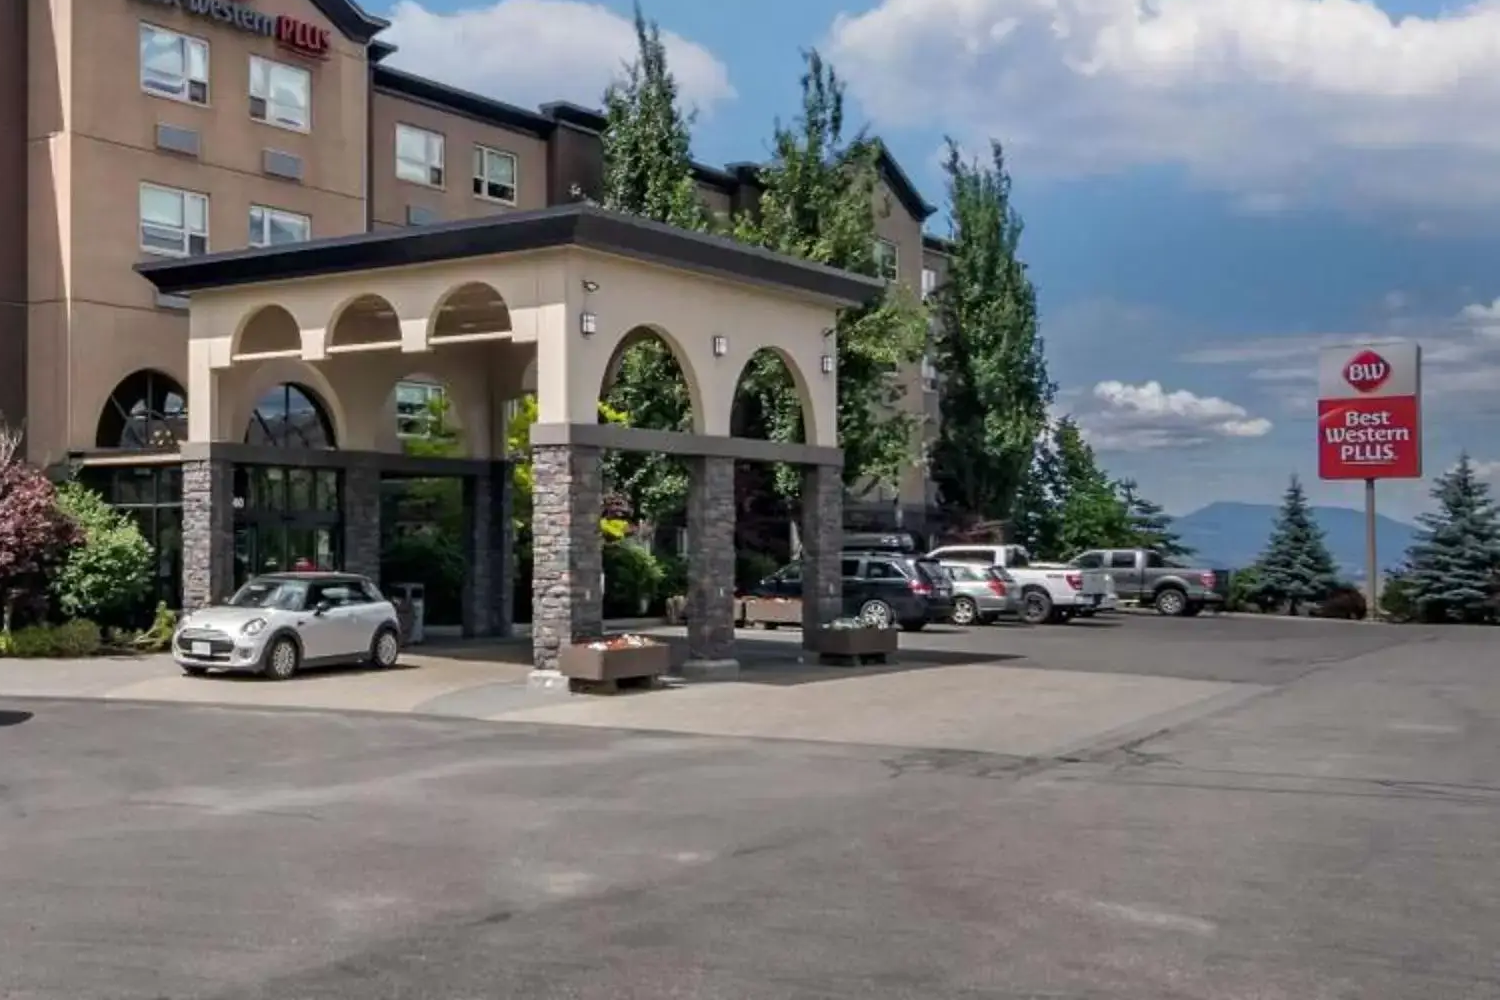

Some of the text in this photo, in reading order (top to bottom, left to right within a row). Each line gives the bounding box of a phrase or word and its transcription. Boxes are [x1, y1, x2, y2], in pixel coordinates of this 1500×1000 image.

[277, 14, 331, 53] PLUS
[1349, 363, 1385, 381] BW
[1345, 411, 1390, 427] Best
[1325, 427, 1409, 443] Western
[1341, 444, 1395, 460] PLUS
